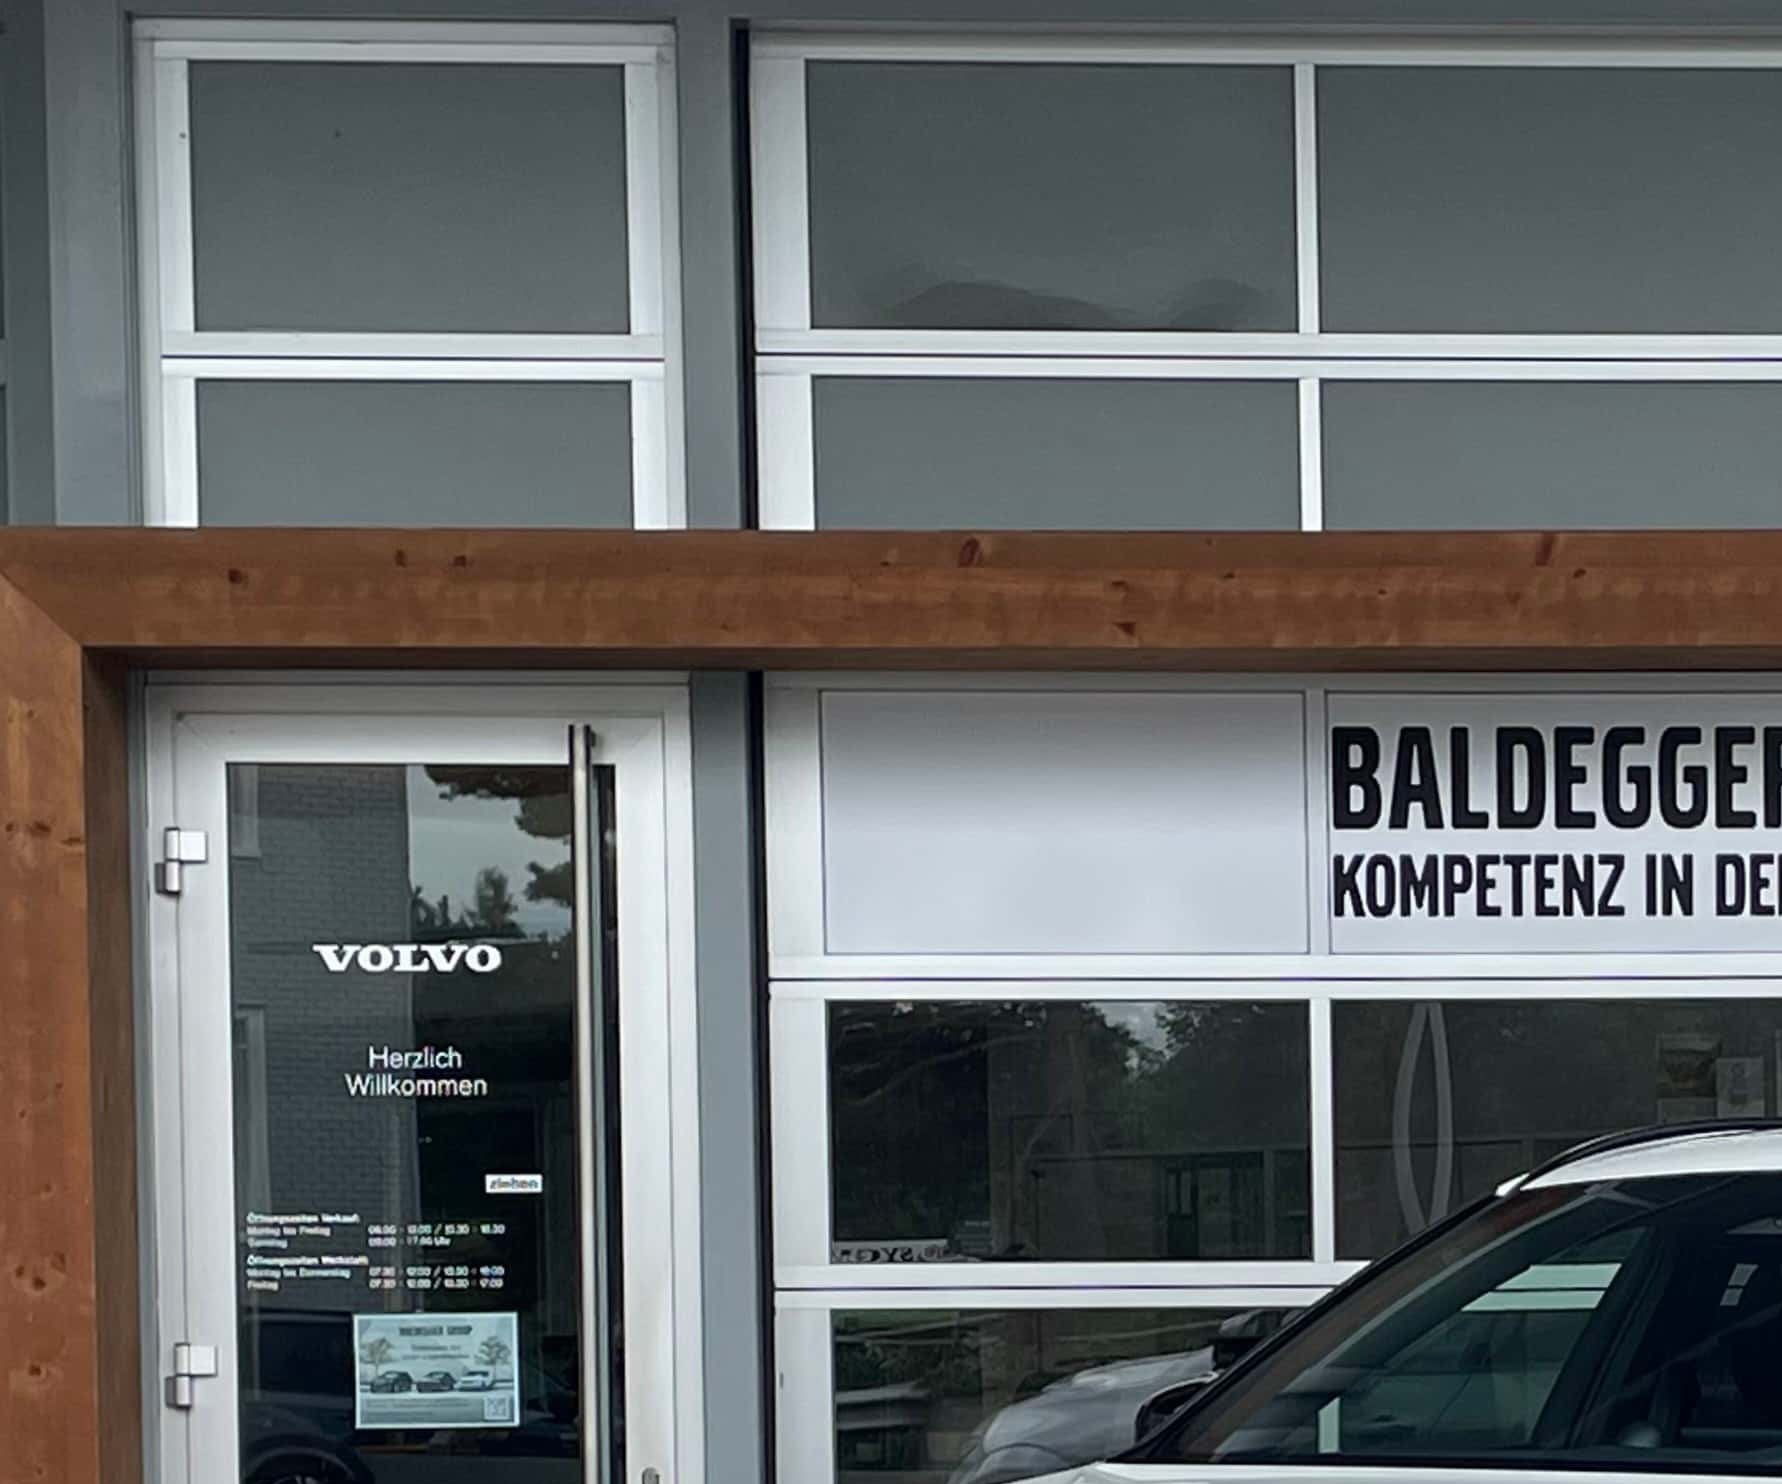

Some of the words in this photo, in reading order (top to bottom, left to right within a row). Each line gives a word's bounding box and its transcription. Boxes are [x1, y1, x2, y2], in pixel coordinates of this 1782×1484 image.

[1333, 852, 1625, 917] KOMPETENZ
[1645, 852, 1694, 917] IN
[313, 944, 502, 972] VOLVO
[368, 1046, 462, 1069] Herzlich
[344, 1073, 488, 1097] Willkommen
[489, 1177, 539, 1190] ziehen
